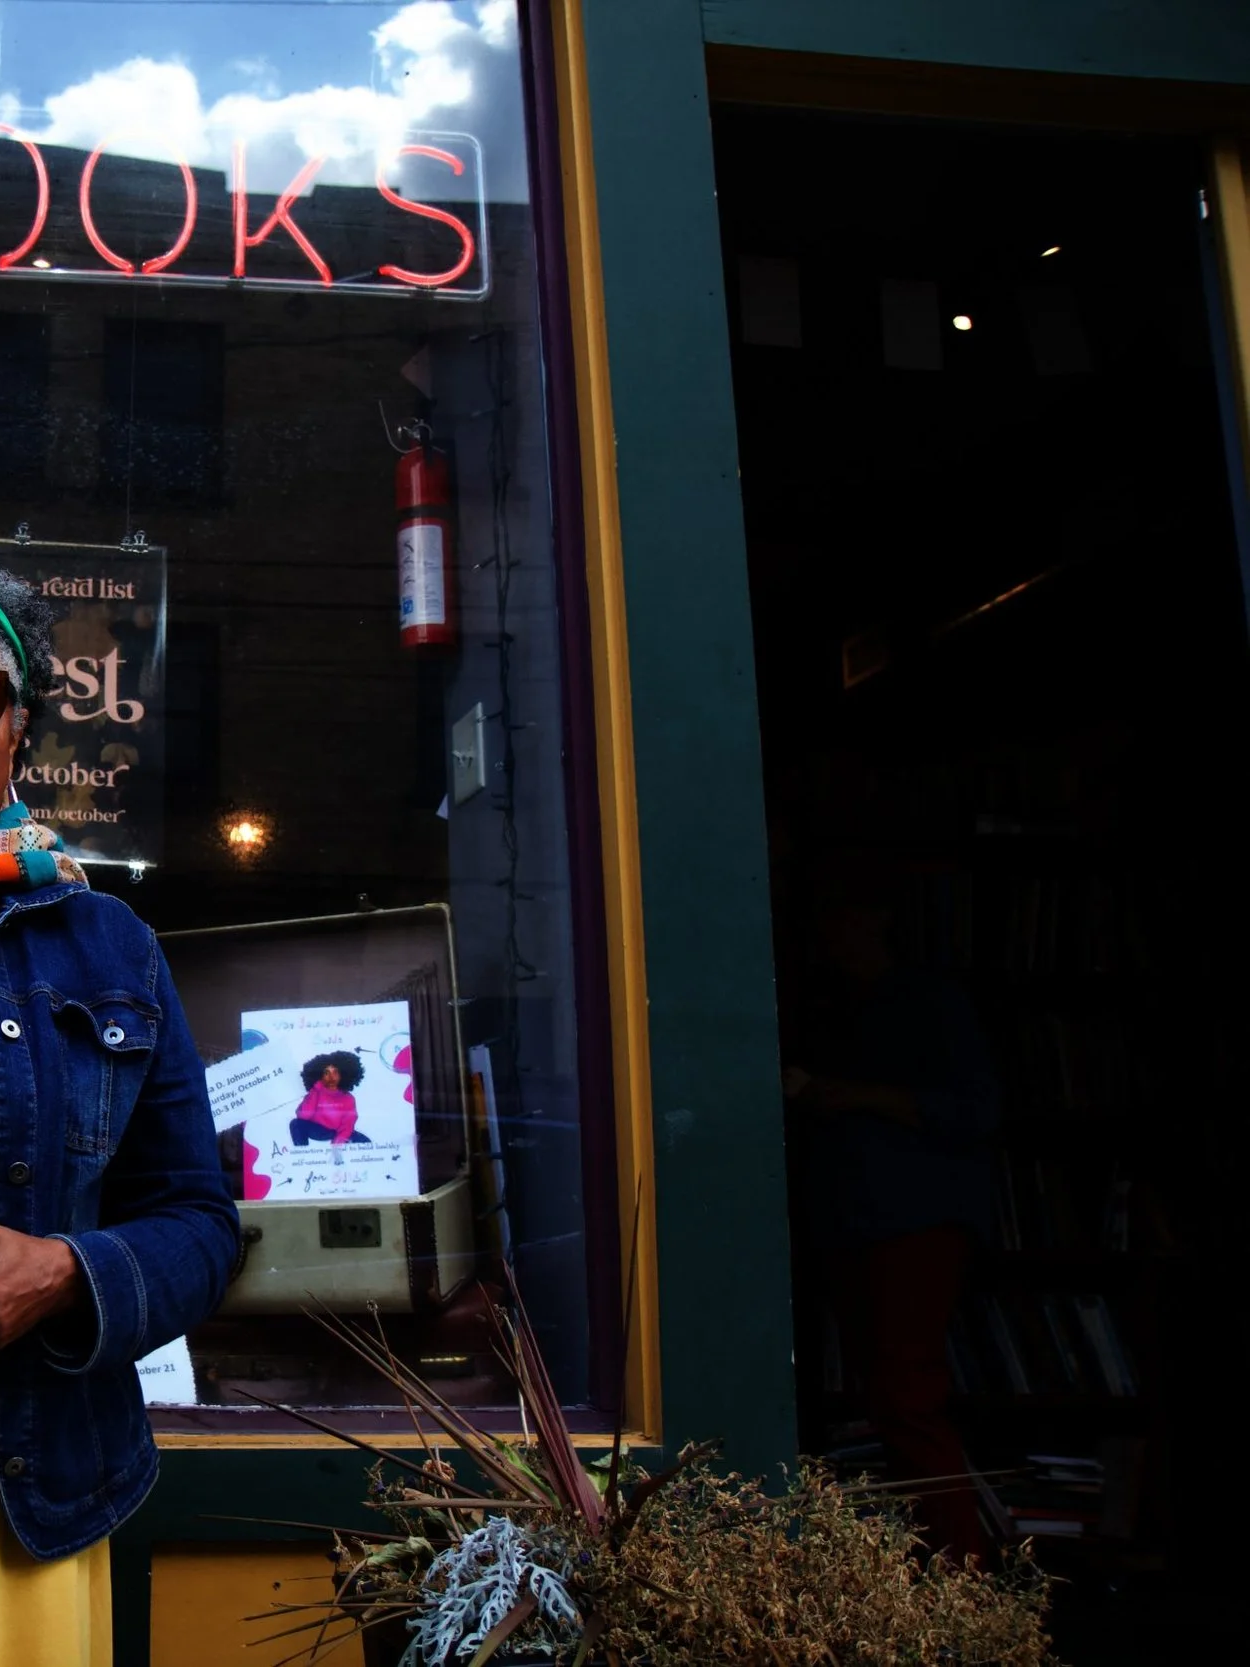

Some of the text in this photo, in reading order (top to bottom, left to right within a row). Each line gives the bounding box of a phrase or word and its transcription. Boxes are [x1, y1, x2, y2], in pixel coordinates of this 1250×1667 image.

[100, 579, 136, 599] list
[210, 1067, 284, 1106] urday, October 14
[215, 1081, 226, 1090] D.
[226, 1066, 261, 1086] Johnson
[230, 1097, 246, 1109] PM
[138, 1363, 176, 1375] ober 21
